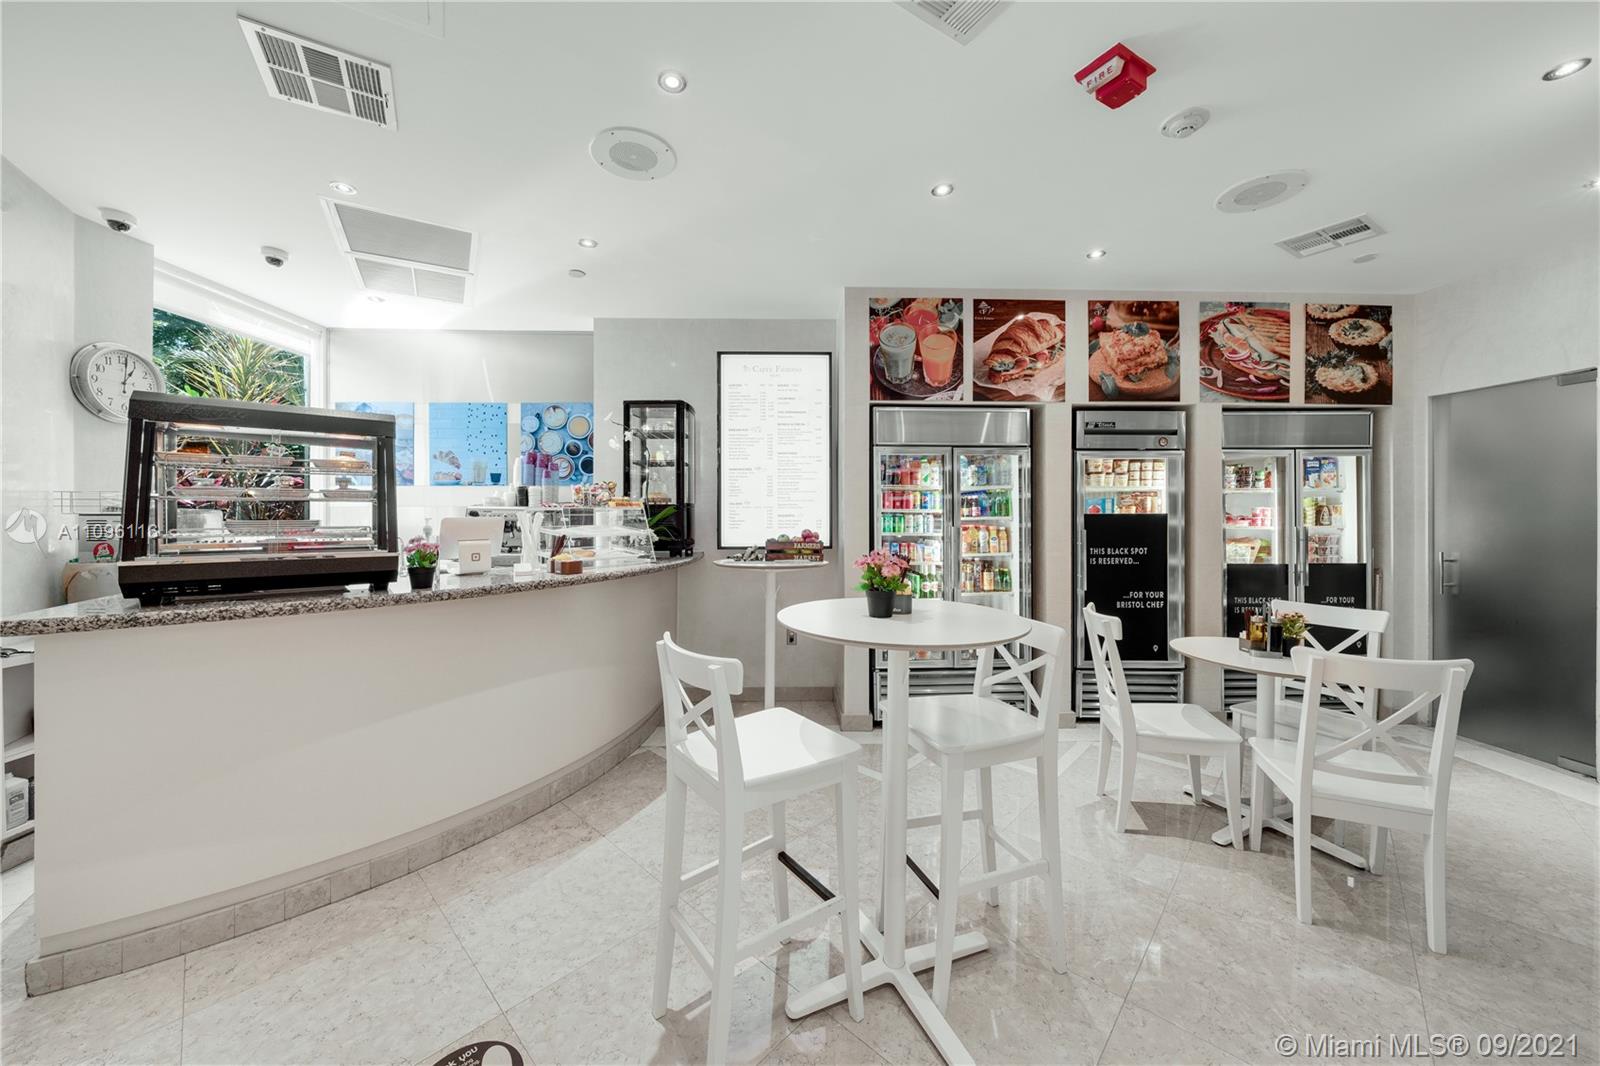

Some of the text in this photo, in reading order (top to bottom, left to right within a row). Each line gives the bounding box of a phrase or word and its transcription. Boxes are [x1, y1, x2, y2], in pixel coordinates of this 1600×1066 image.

[1086, 65, 1113, 88] FIRE
[104, 356, 112, 365] 11
[96, 363, 105, 373] 10
[91, 375, 98, 383] 9
[142, 371, 148, 380] 2
[146, 383, 152, 391] 3
[96, 387, 103, 396] 8
[107, 397, 114, 406] 7
[121, 403, 128, 411] 6
[1090, 547, 1148, 555] THIS BLACK SPOT
[1090, 557, 1097, 565] IS
[1145, 591, 1164, 599] YOUR
[1339, 596, 1355, 604] YOUR
[1116, 601, 1164, 609] BRISTOL CHEF
[1234, 606, 1240, 614] IS
